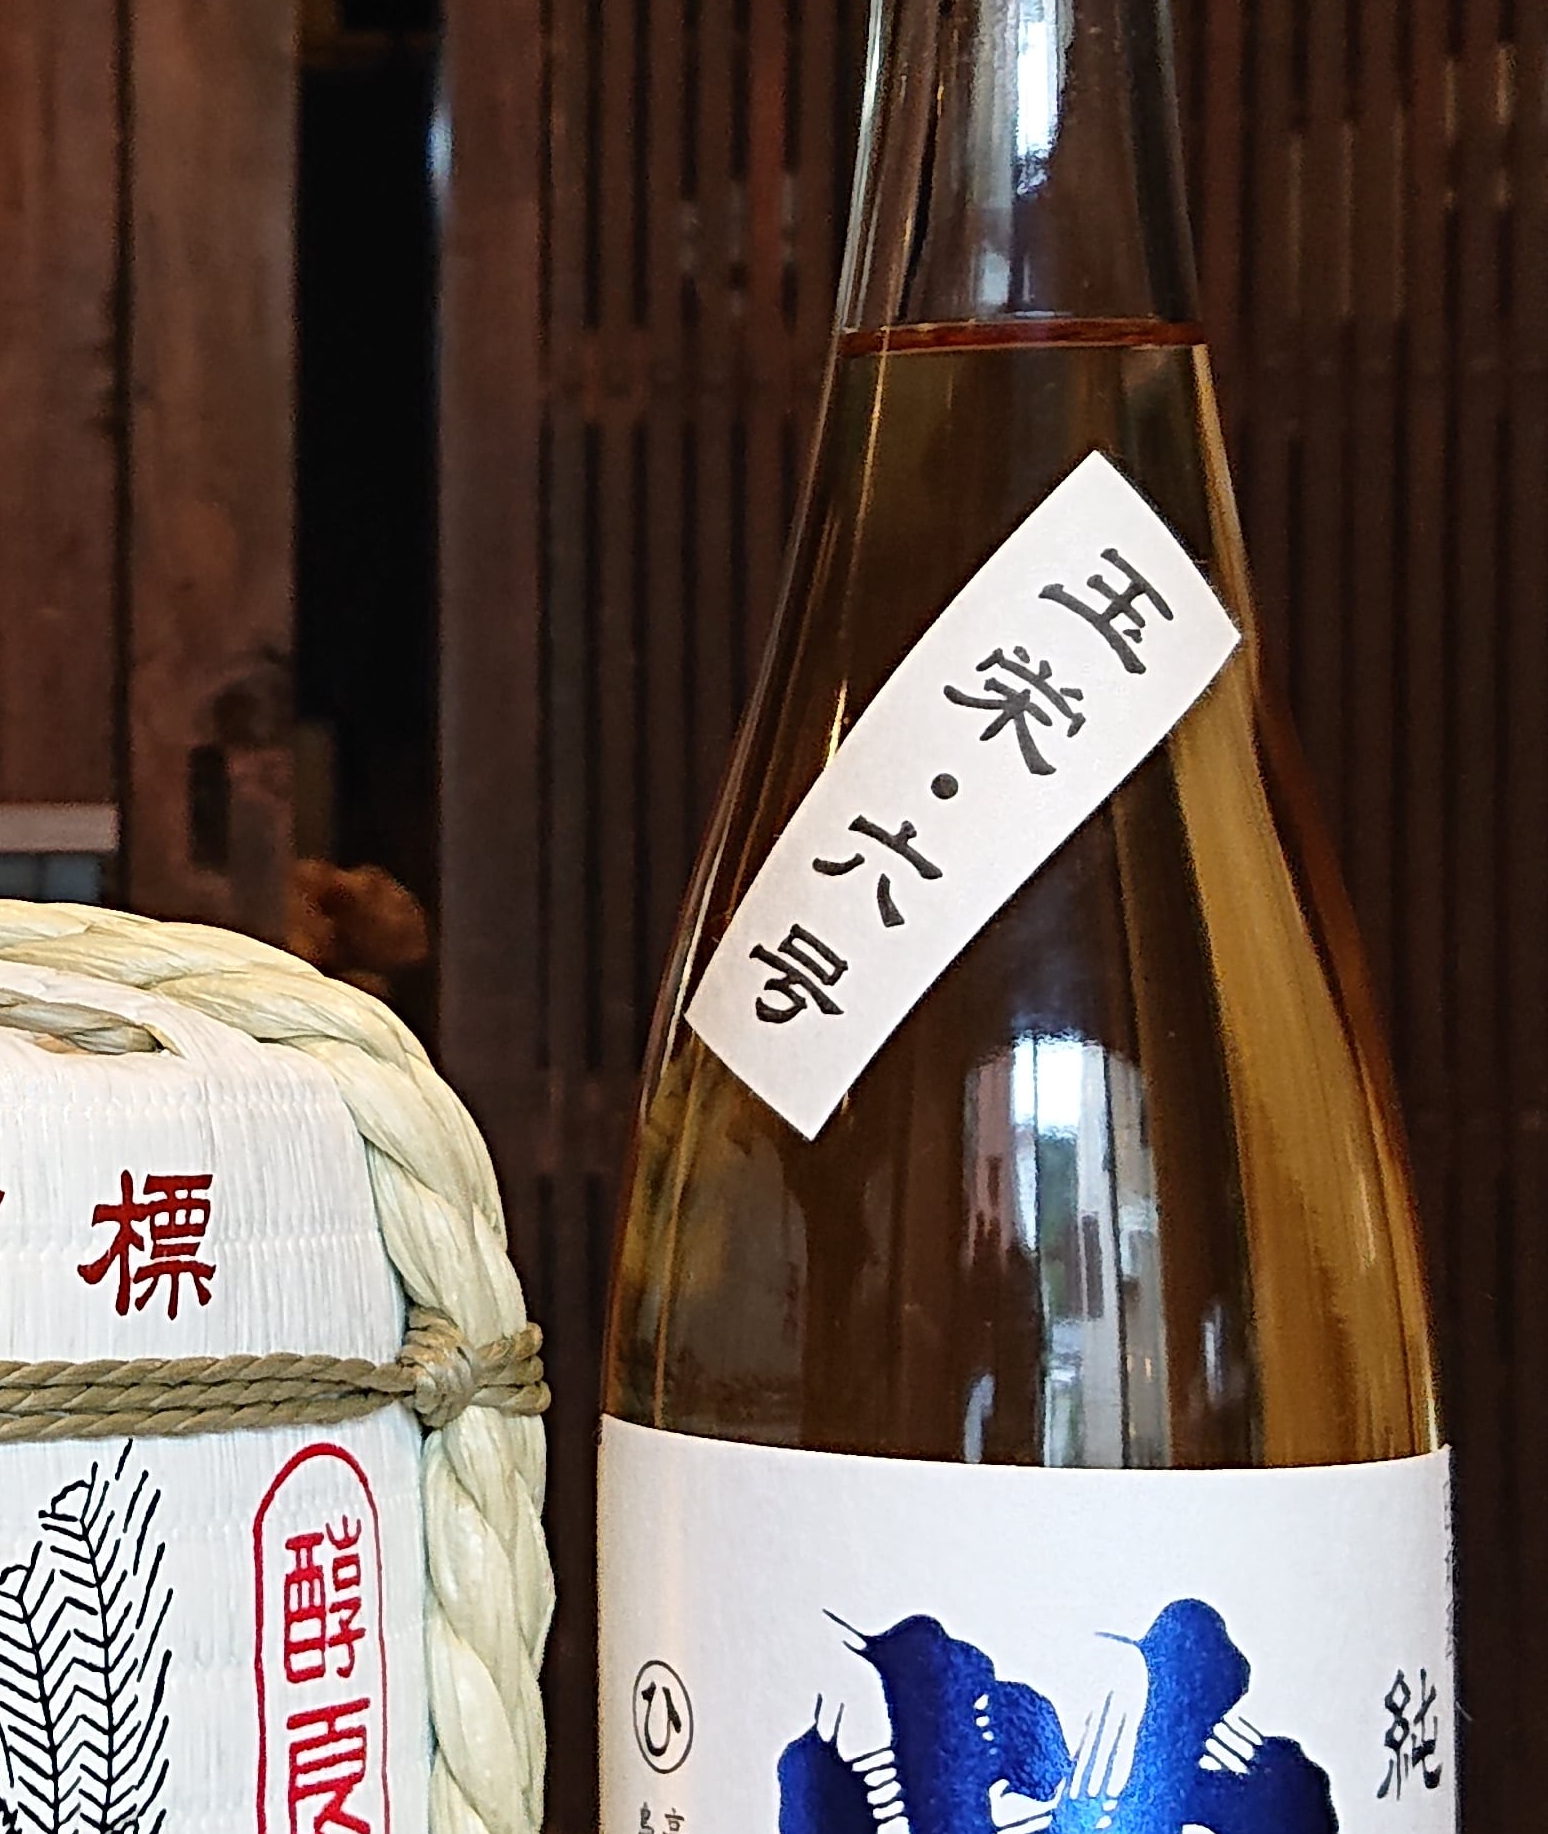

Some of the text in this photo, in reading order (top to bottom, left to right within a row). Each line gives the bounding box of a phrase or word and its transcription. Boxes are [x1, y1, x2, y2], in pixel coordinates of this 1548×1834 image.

[749, 548, 1173, 1024] 玉栄・六号
